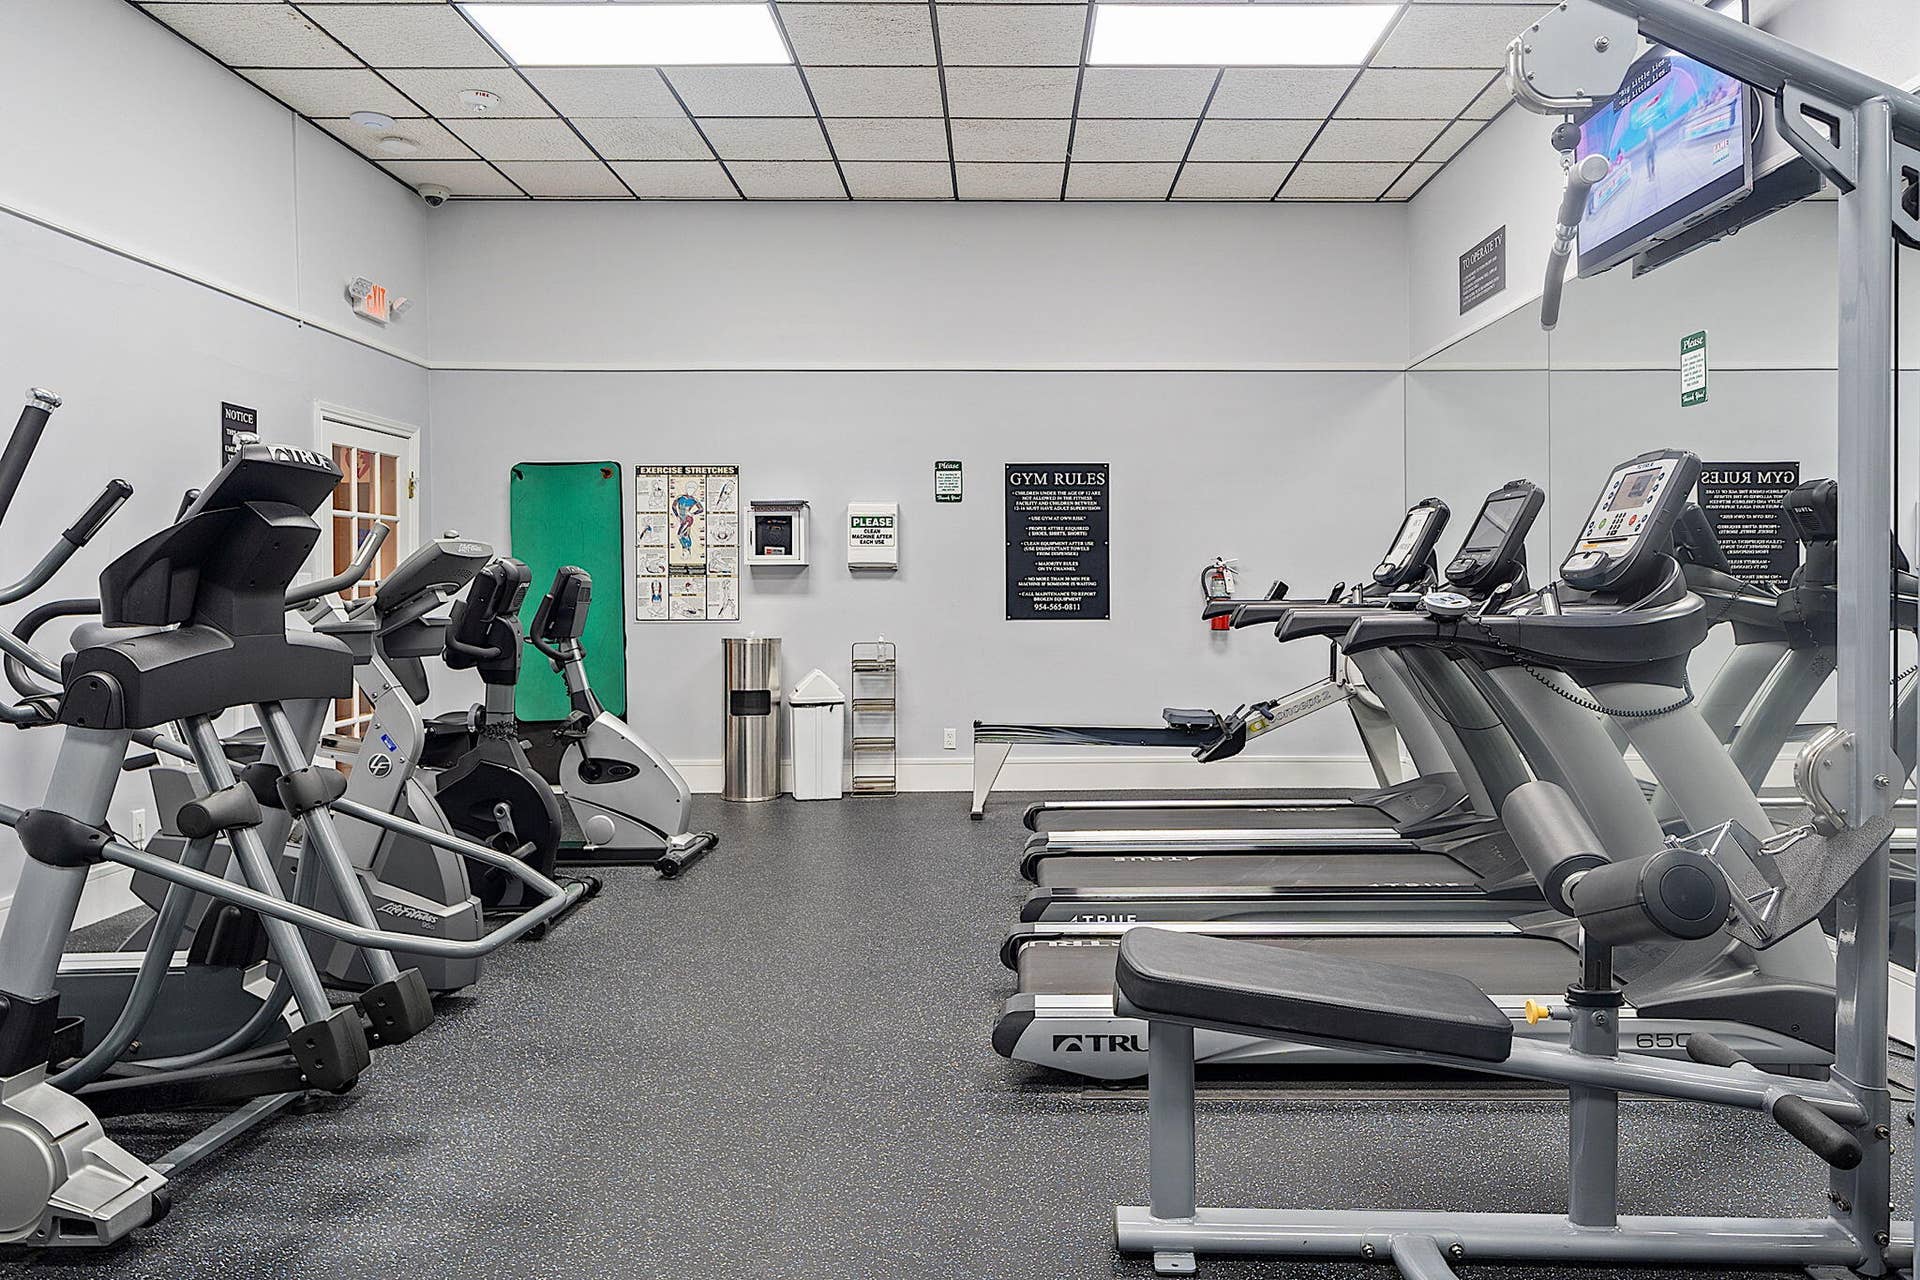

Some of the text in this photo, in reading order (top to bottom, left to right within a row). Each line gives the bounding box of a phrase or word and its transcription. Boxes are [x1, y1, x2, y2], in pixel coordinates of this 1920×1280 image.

[1470, 240, 1494, 265] OPERATE
[366, 284, 386, 320] EXIT
[1683, 336, 1704, 350] Please
[225, 408, 254, 424] NOTICE
[284, 447, 332, 471] TRUE
[1010, 472, 1105, 485] GYM RULES
[852, 518, 892, 527] PLEASE
